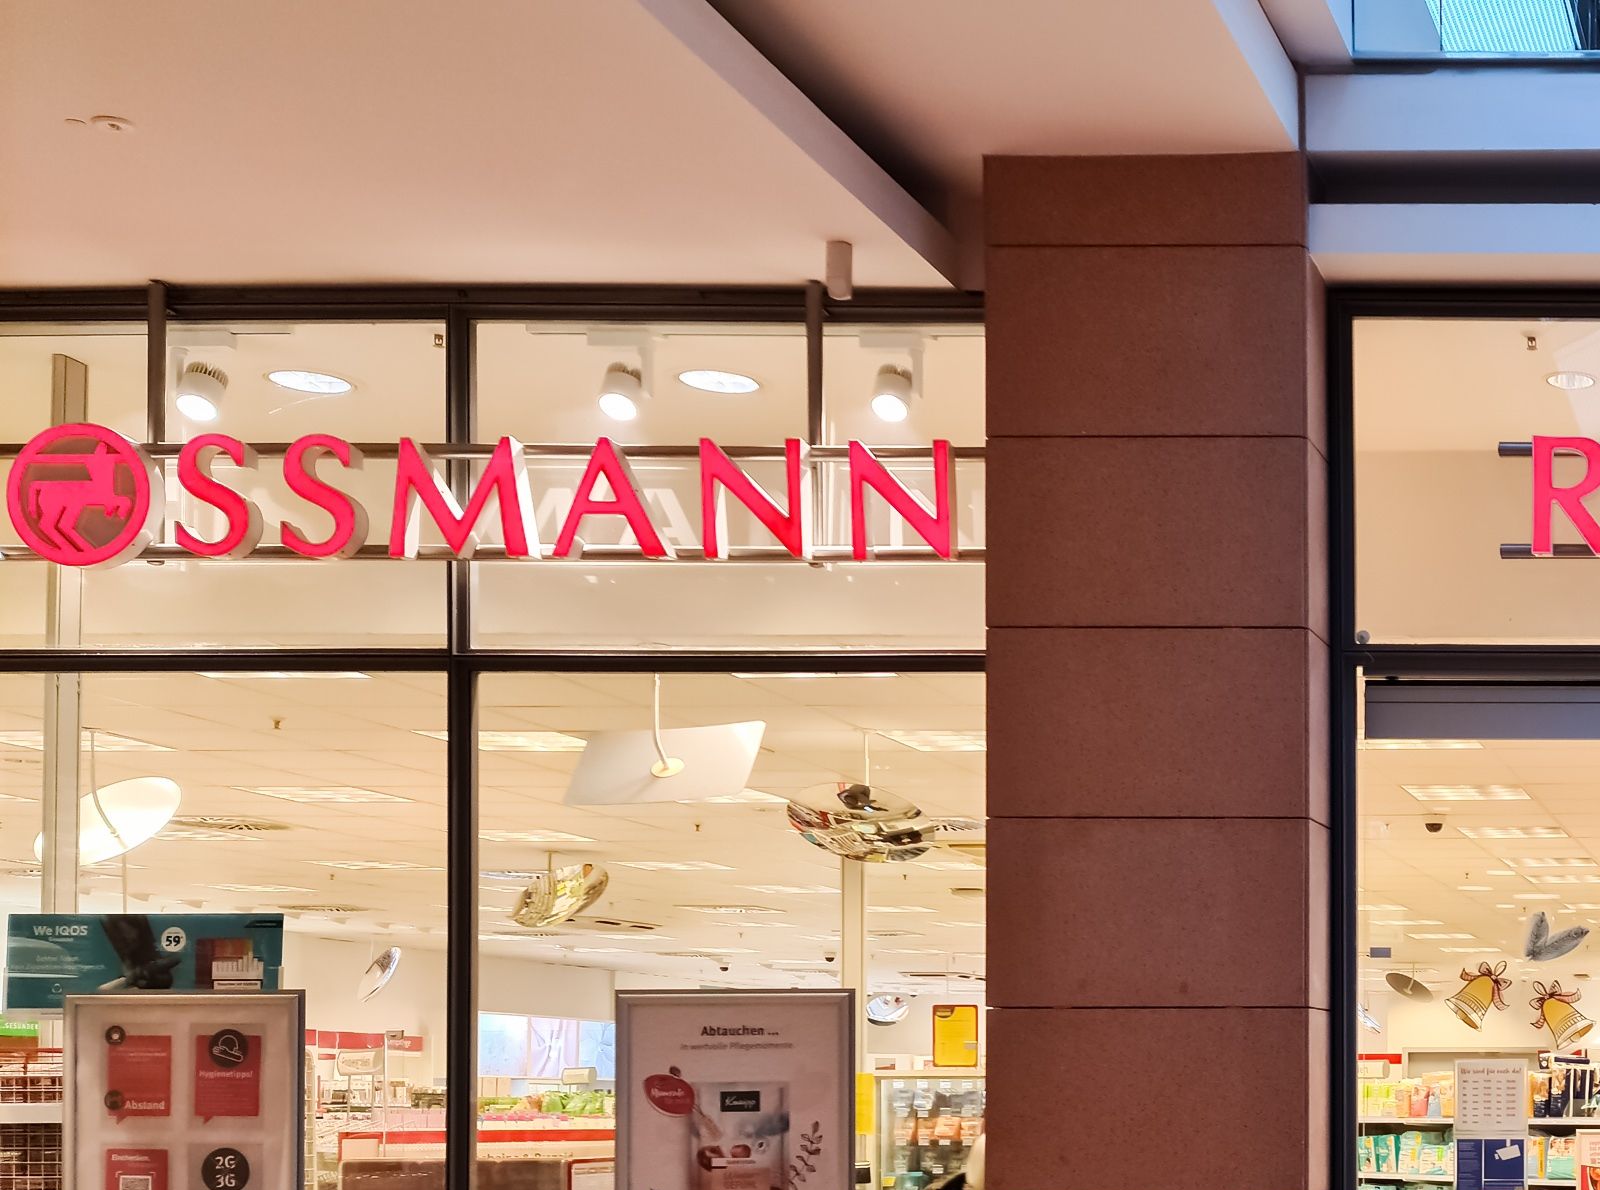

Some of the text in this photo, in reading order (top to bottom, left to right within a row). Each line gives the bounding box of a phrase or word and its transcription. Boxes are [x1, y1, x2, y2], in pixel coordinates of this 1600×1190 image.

[33, 925, 89, 937] We IQOS
[701, 1025, 765, 1037] Abtauchen
[124, 1100, 166, 1110] Abstand
[214, 1155, 237, 1169] 2G
[214, 1174, 237, 1188] 3G
